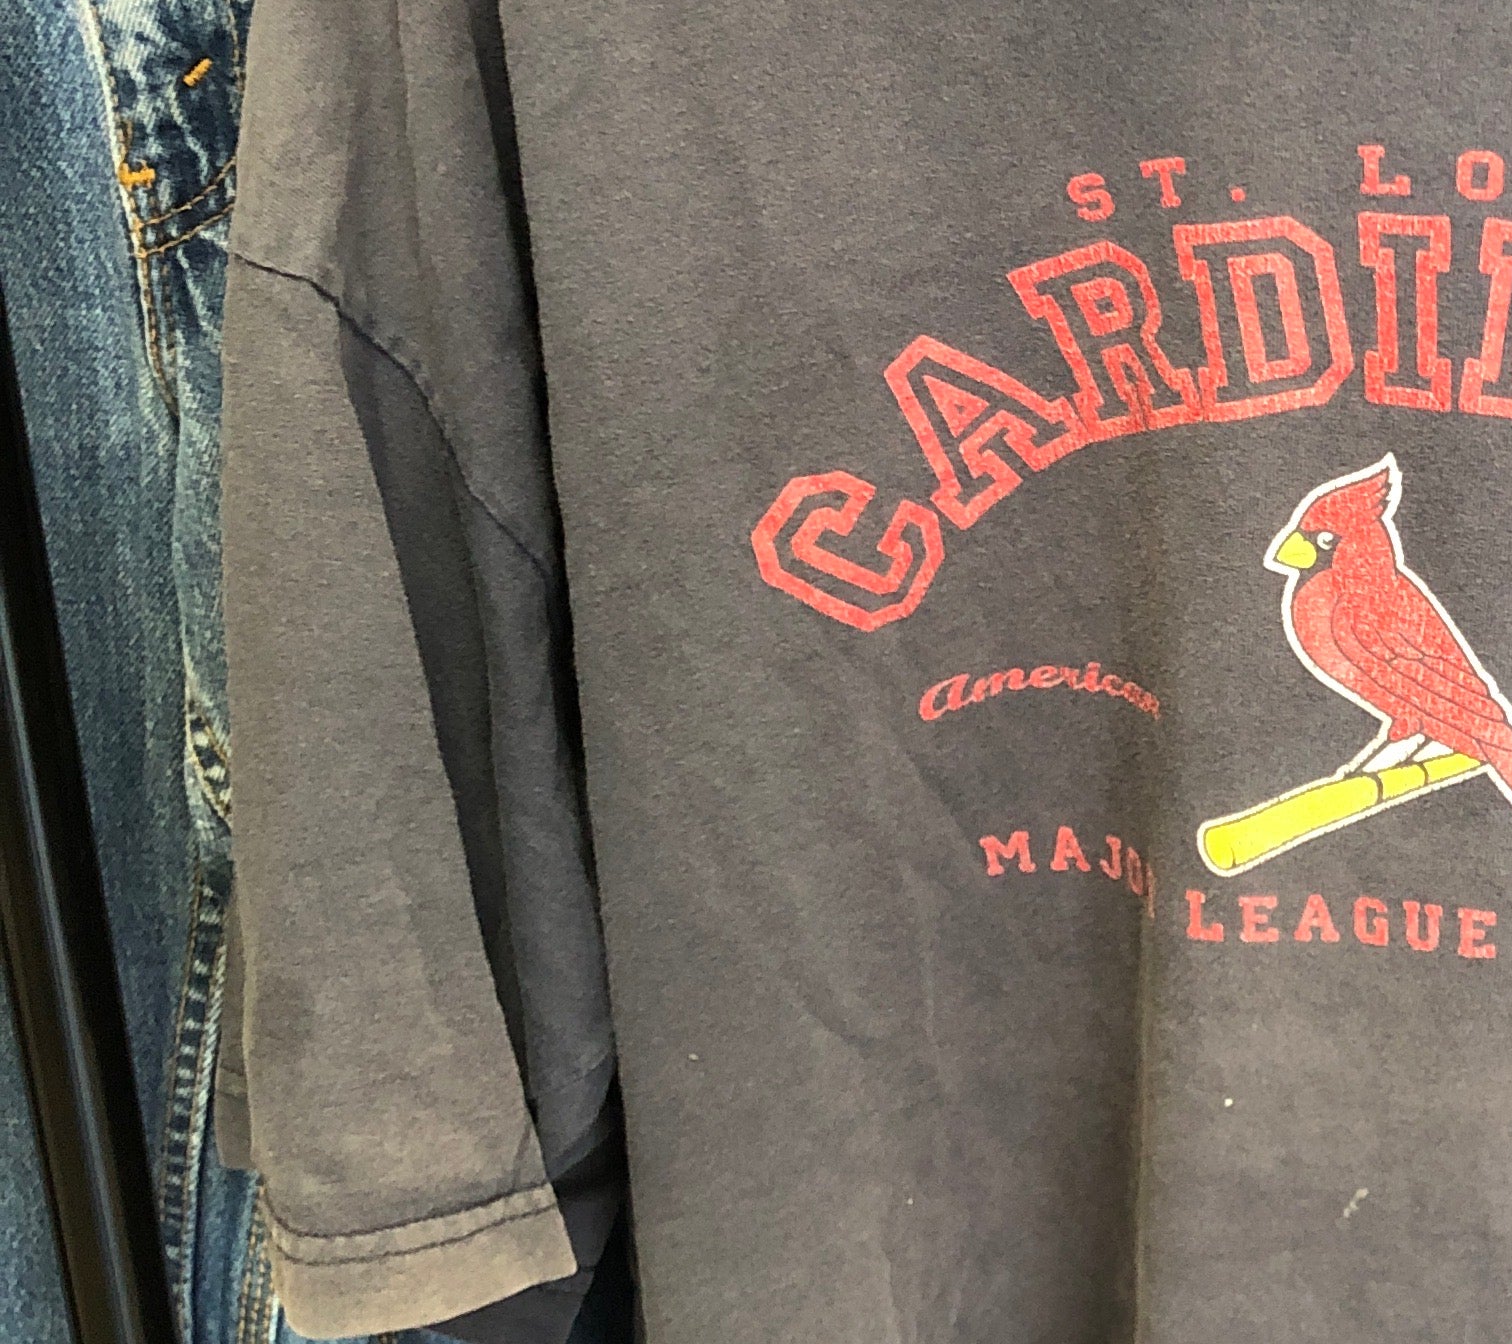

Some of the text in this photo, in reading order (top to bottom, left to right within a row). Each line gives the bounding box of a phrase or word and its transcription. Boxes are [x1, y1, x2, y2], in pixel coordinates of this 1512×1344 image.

[1065, 155, 1248, 224] ST.
[918, 660, 1162, 722] American
[1184, 887, 1499, 962] LEAGUE
